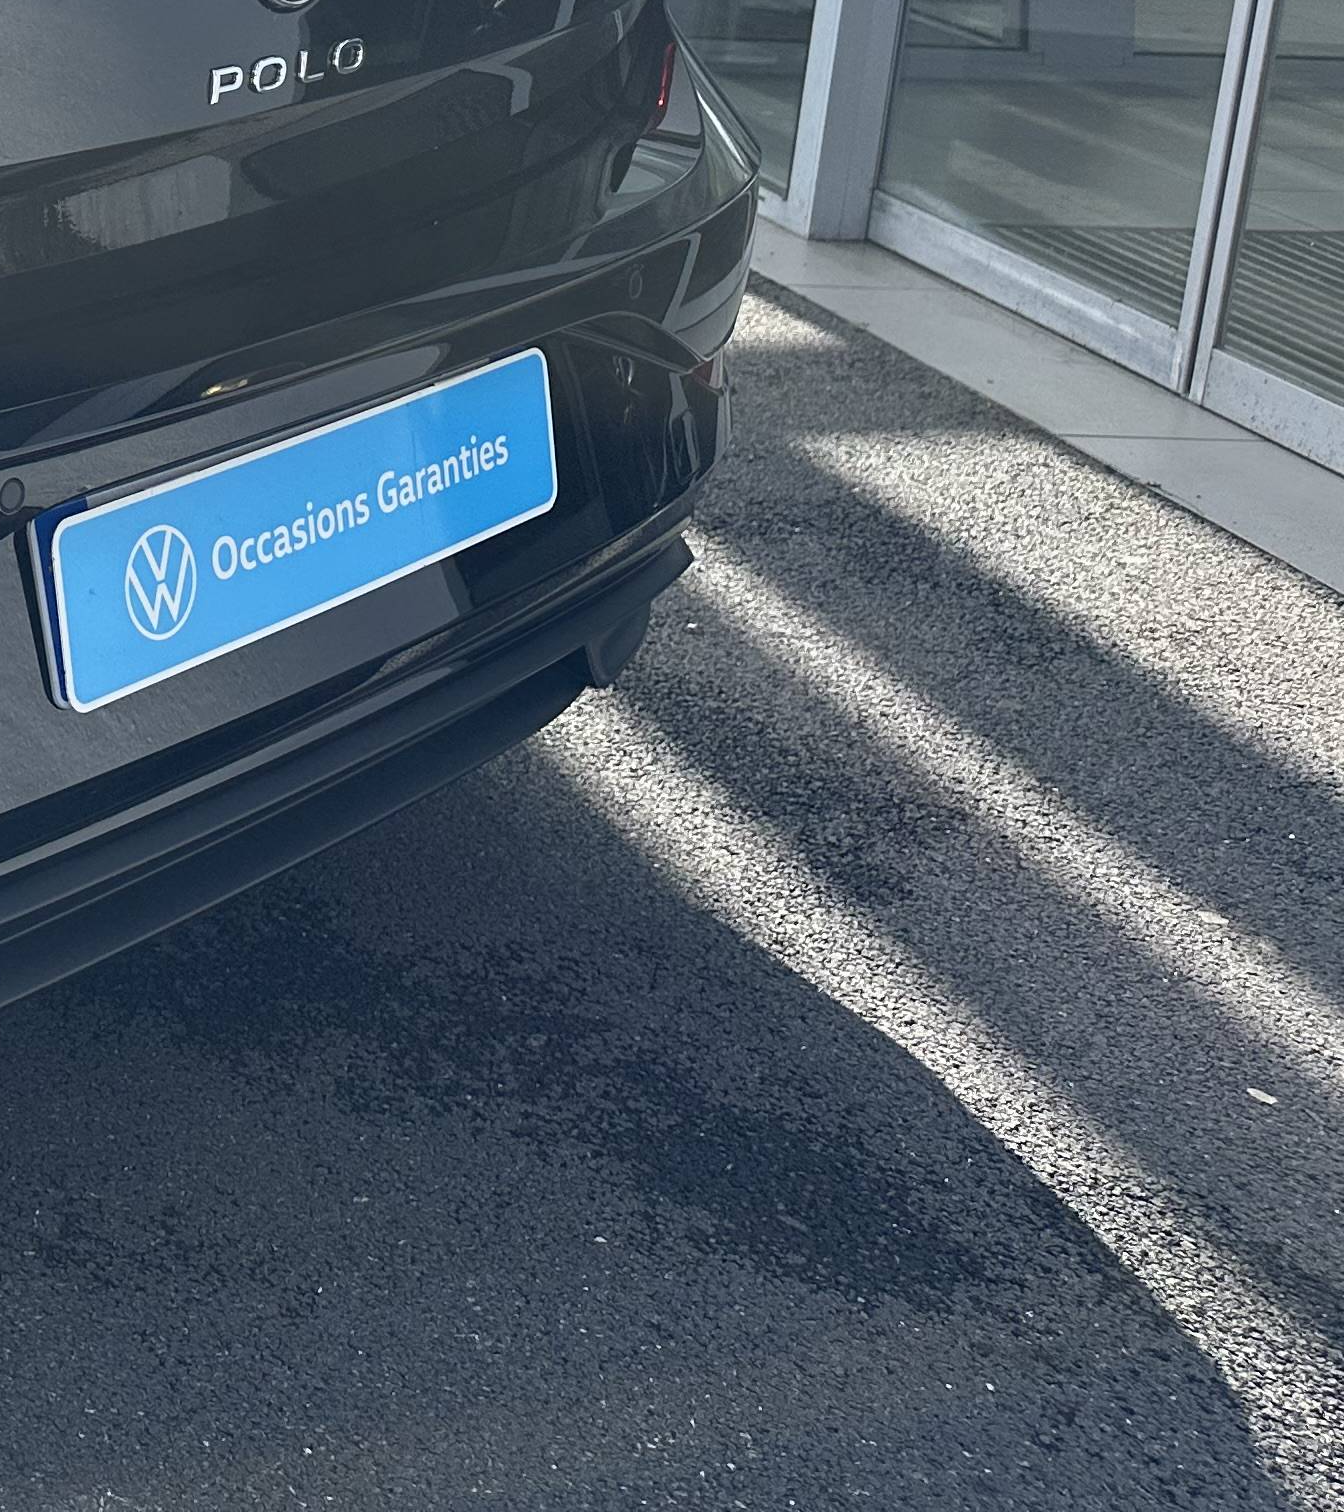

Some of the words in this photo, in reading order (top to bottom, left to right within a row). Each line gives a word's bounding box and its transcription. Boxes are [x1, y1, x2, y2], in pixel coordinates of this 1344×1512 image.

[208, 37, 365, 105] POLO
[211, 491, 370, 581] Occasions
[376, 434, 509, 514] Garanties
